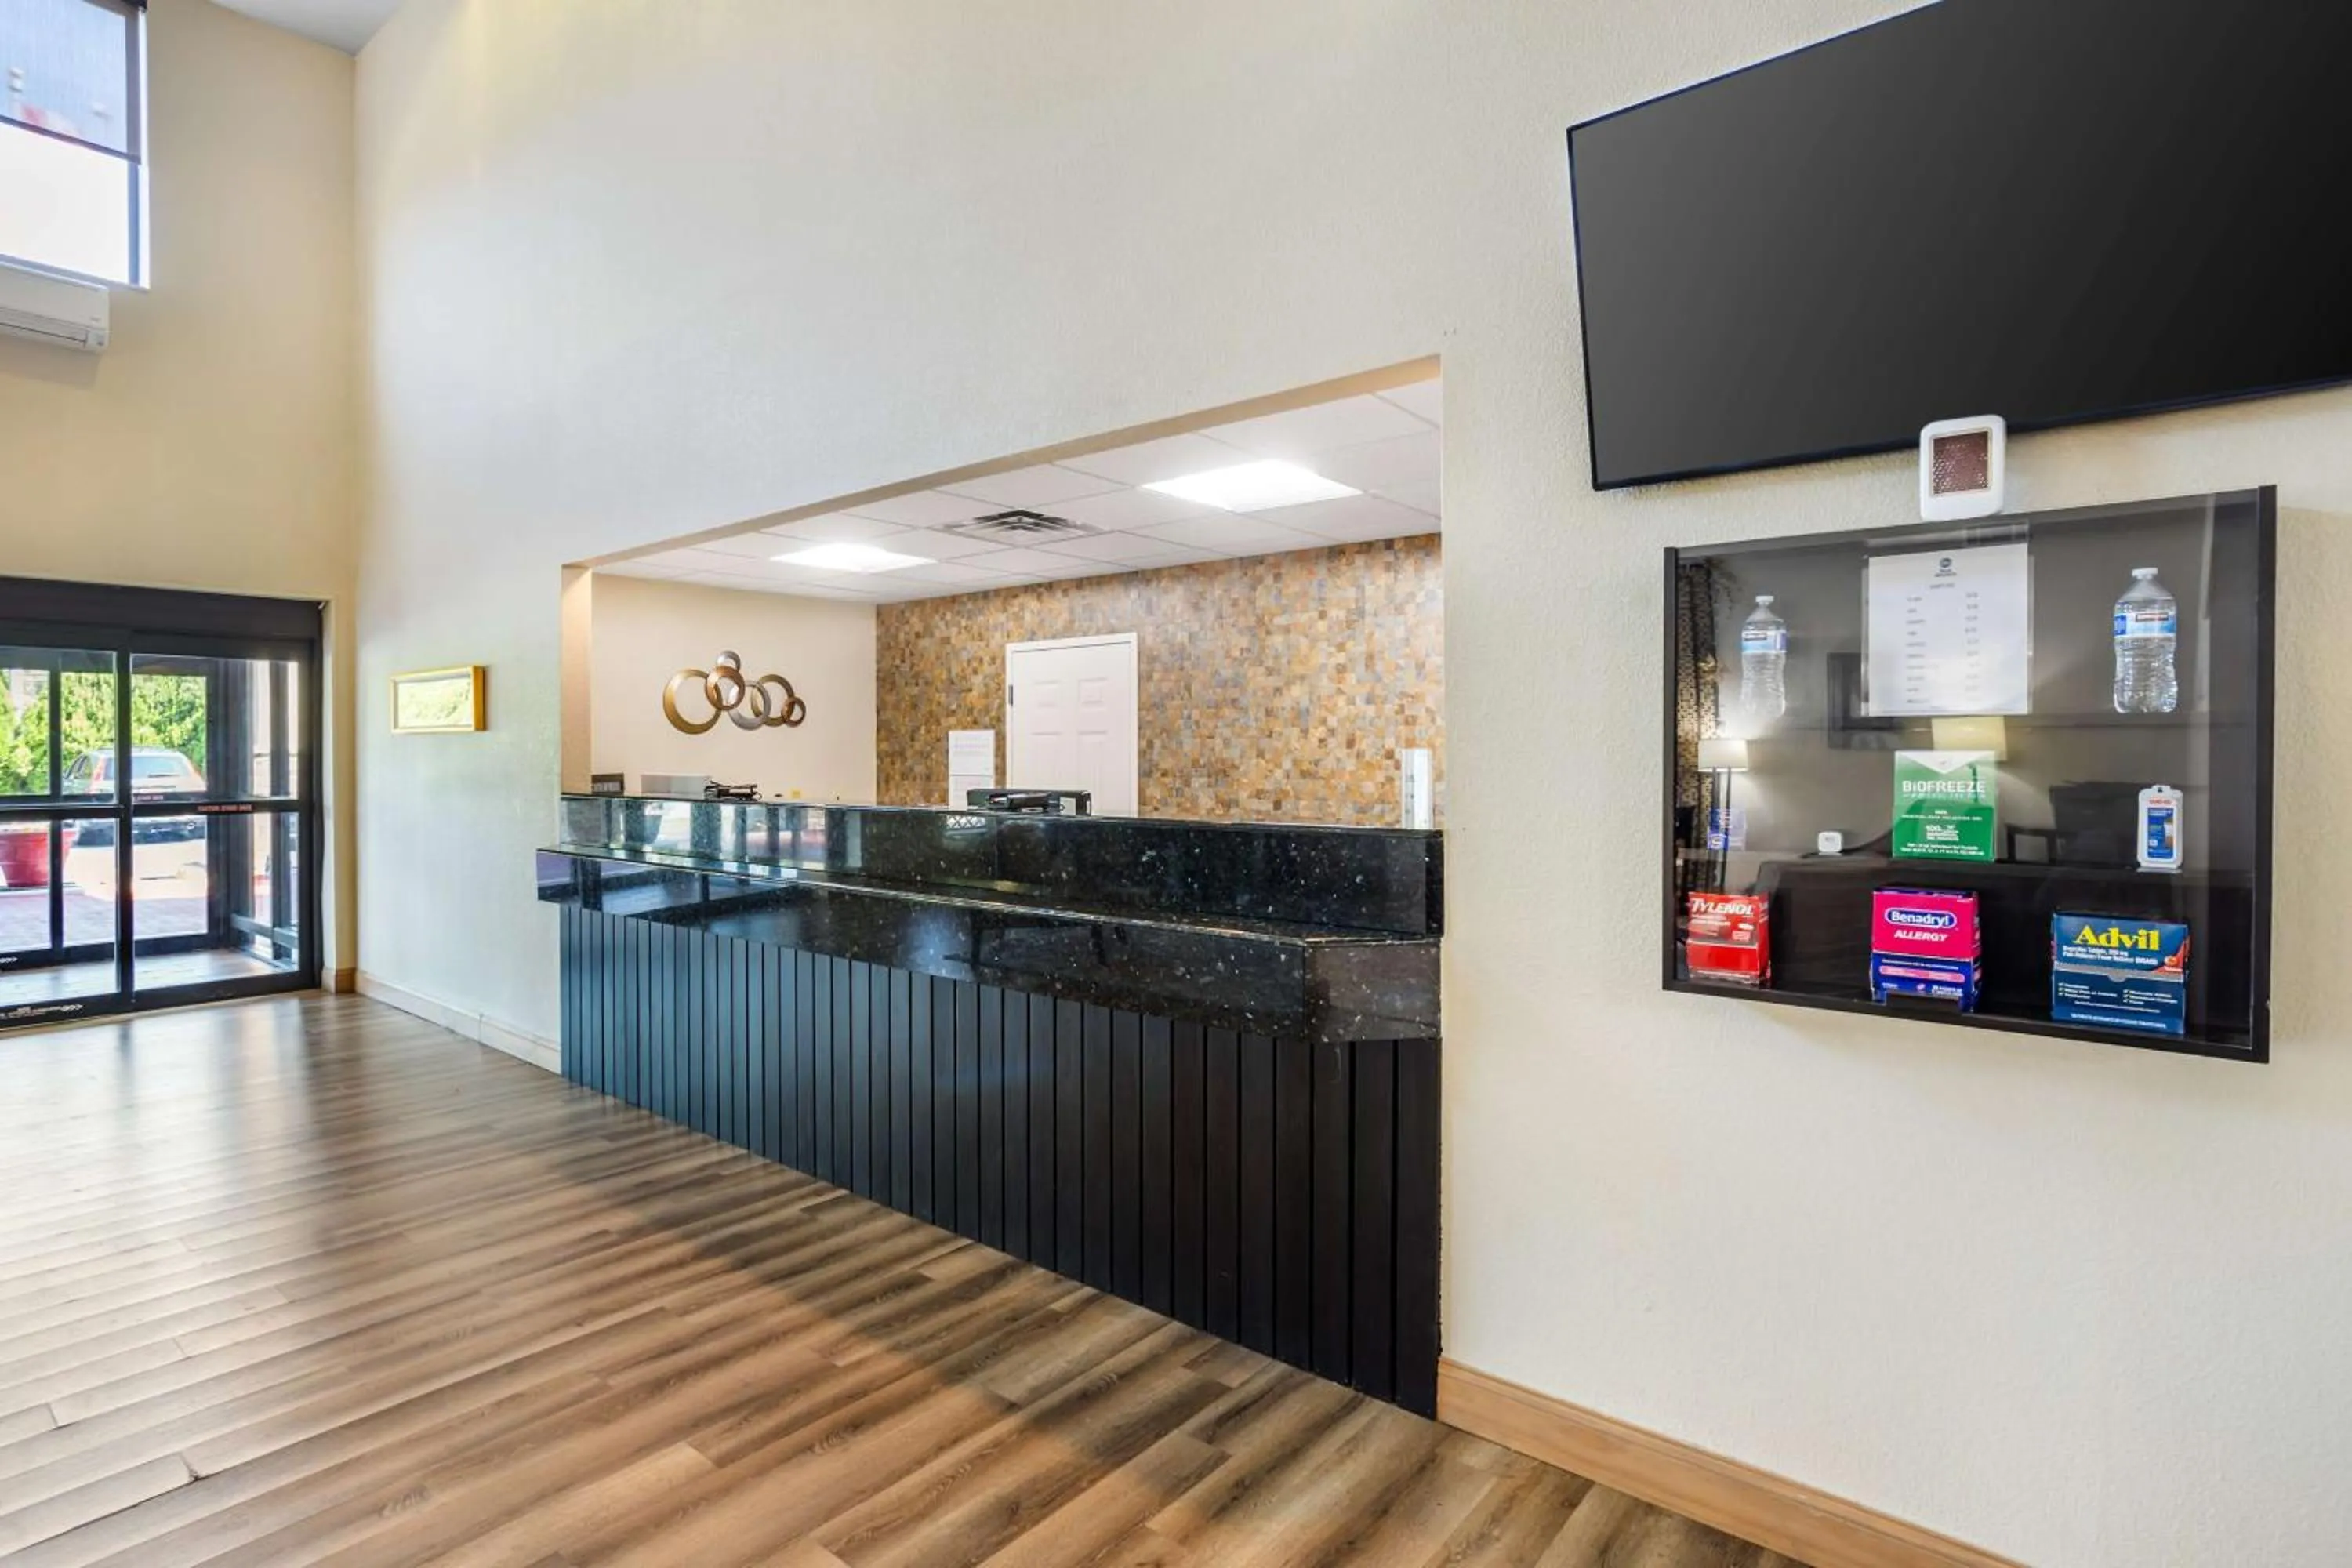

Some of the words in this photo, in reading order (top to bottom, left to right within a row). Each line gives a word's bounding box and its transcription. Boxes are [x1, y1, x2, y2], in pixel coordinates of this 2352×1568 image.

[1690, 898, 1754, 916] TYLENOL
[1891, 910, 1950, 926] Benadryl
[1894, 930, 1948, 942] ALLERGY
[2072, 924, 2160, 951] Advil
